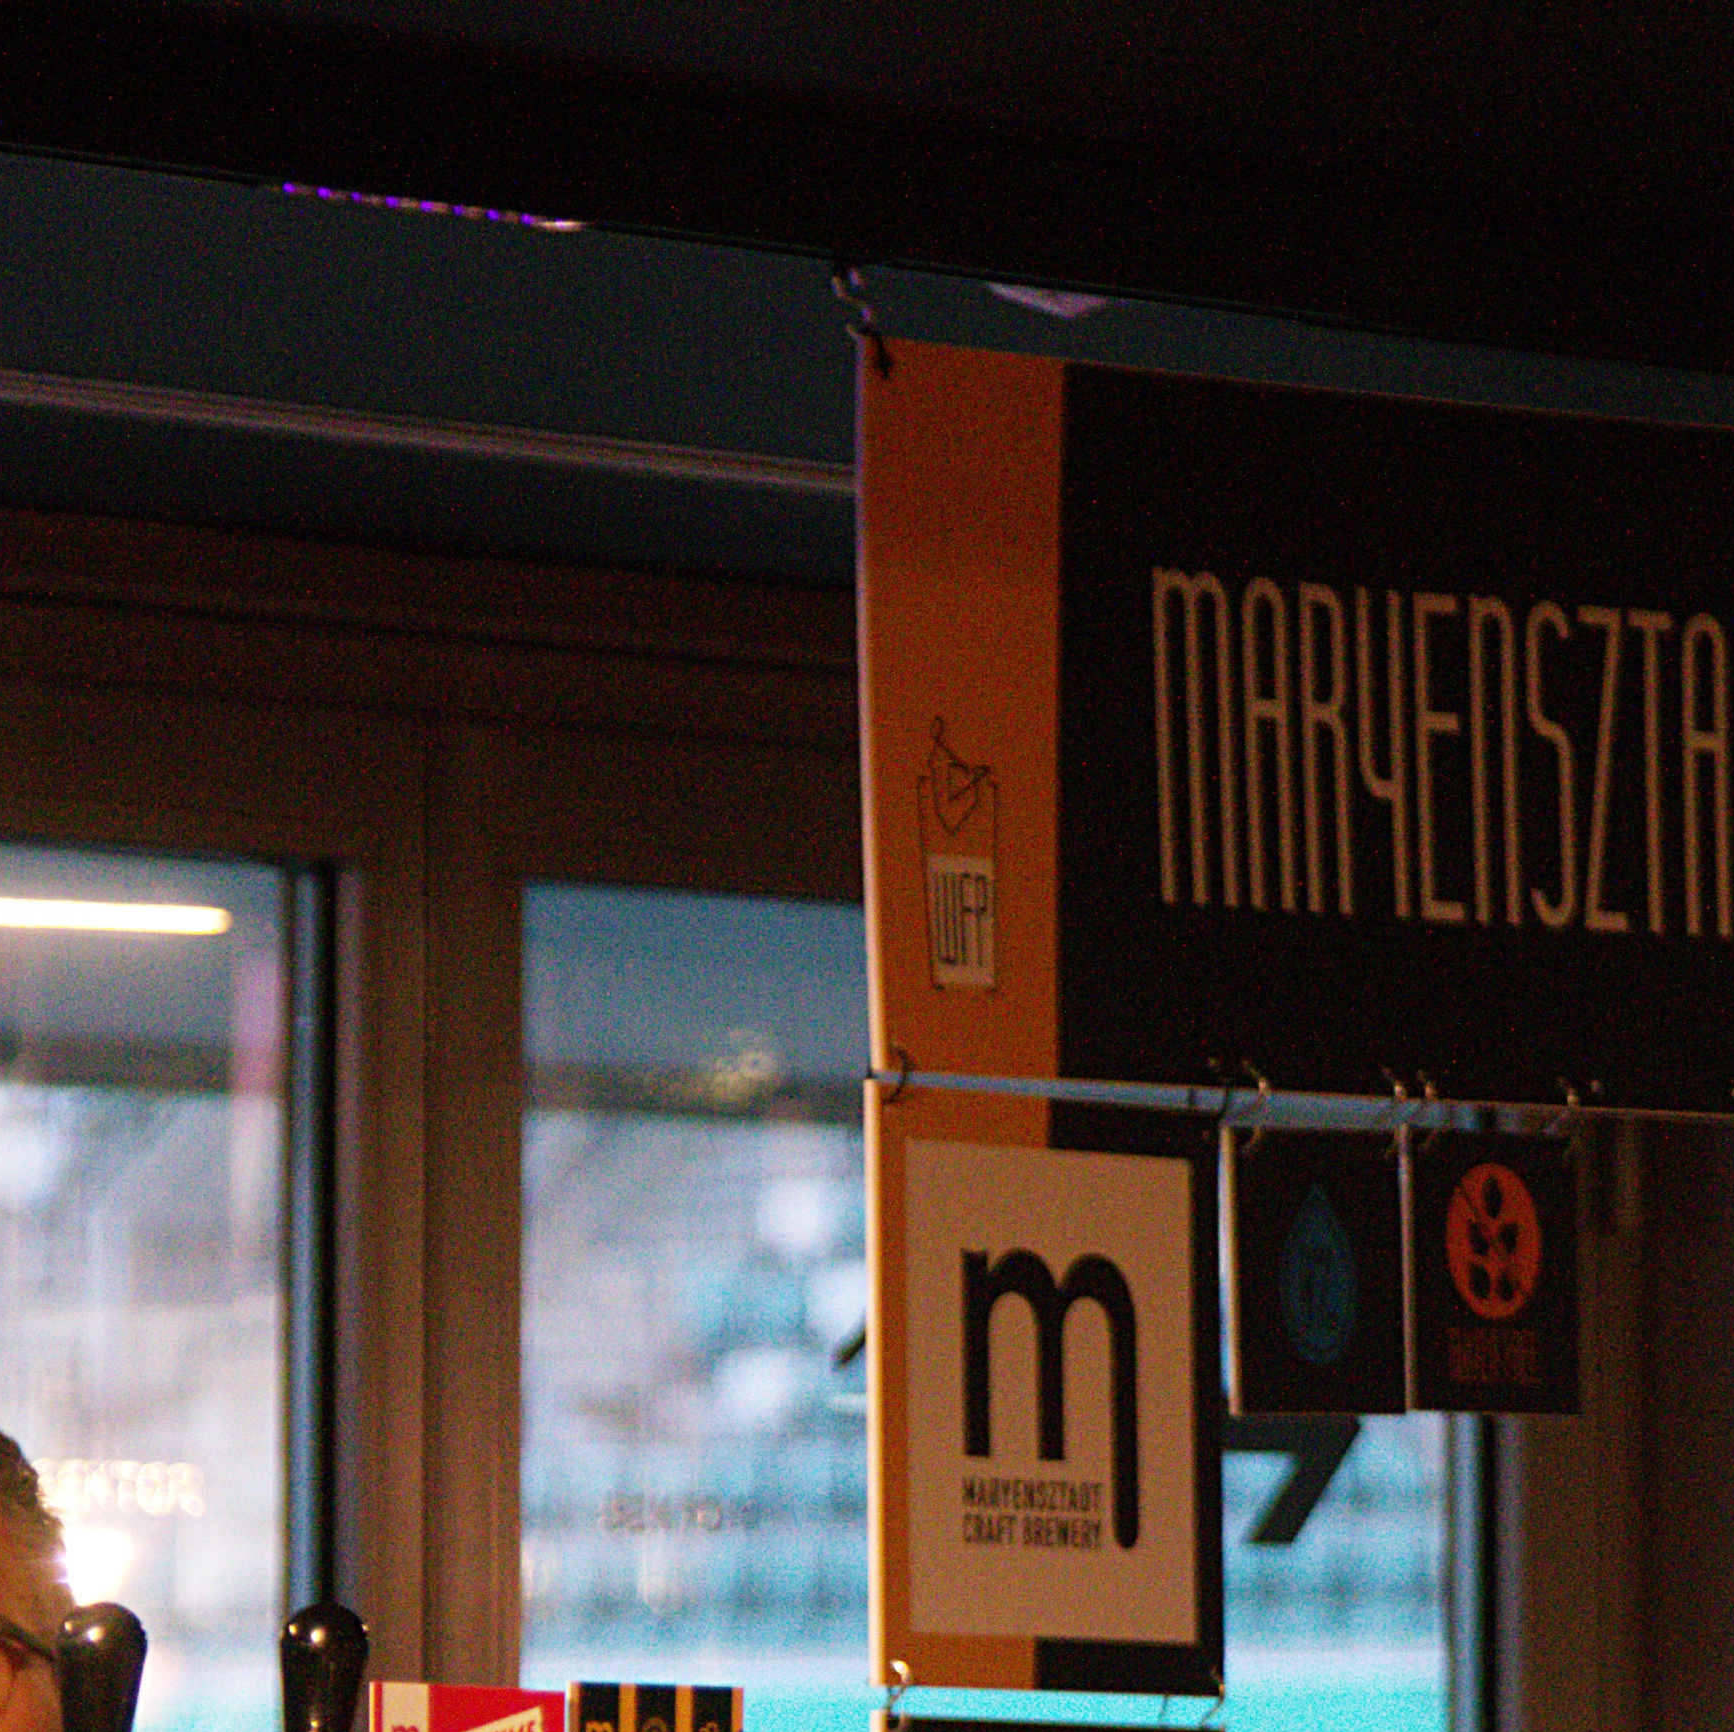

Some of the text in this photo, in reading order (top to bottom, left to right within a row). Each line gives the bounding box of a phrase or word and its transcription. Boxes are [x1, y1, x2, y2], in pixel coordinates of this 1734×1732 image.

[961, 1477, 1103, 1515] MARYENSZTADT
[961, 1512, 1103, 1547] CRAFT BREWERY
